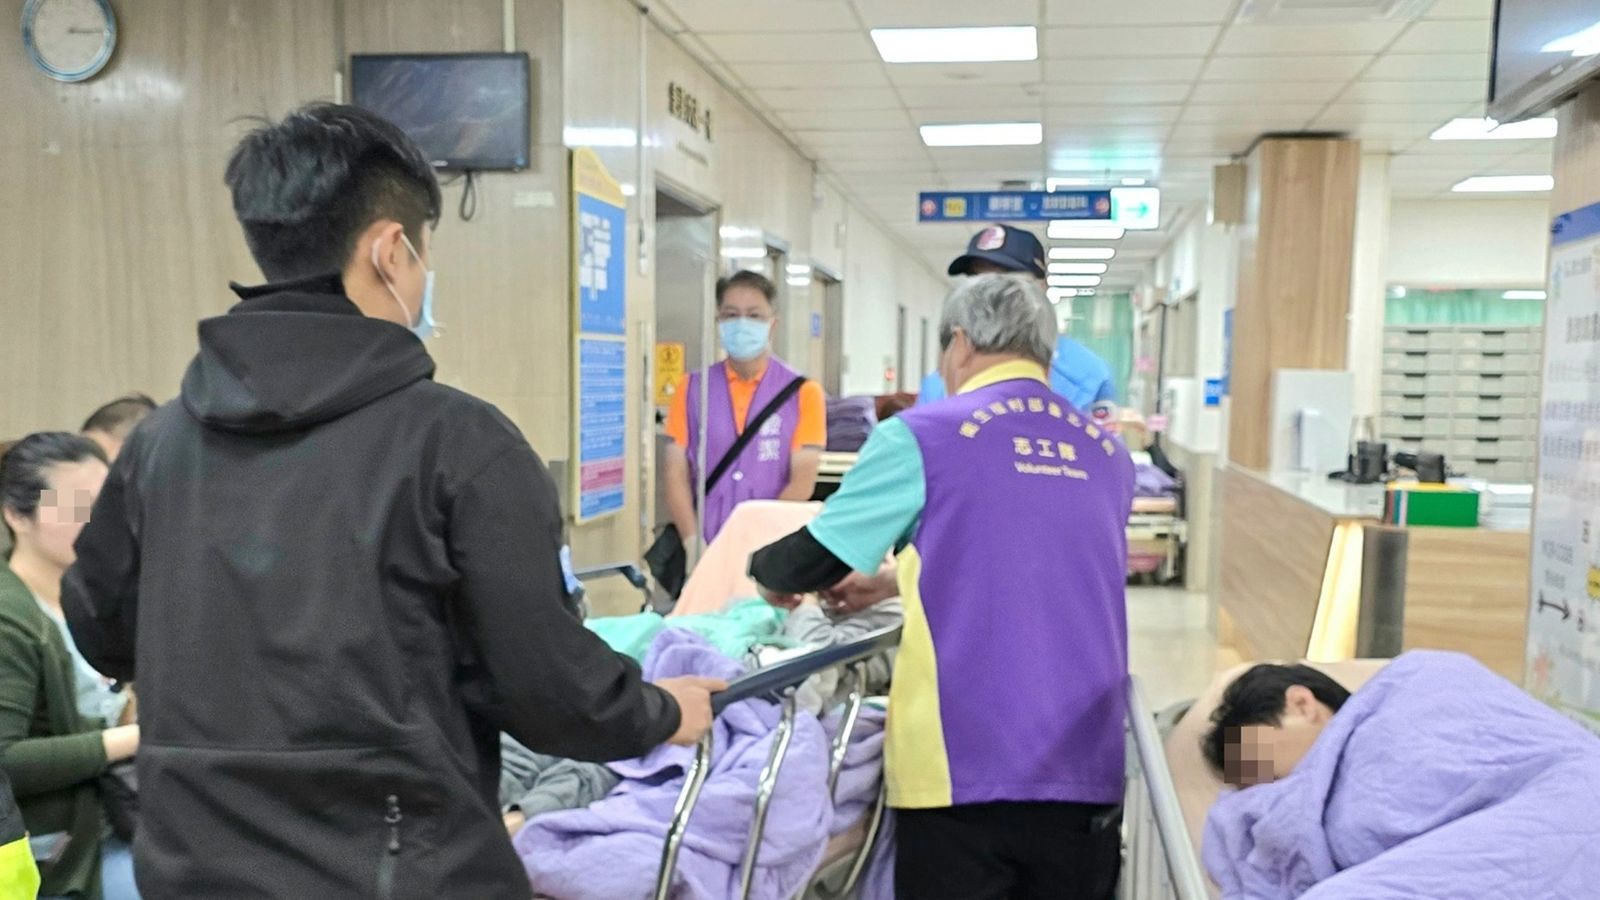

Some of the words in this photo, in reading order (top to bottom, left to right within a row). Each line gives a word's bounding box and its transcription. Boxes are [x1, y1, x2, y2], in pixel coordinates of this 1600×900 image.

[1012, 436, 1077, 462] 志工隊
[1014, 461, 1061, 476] Volunteer
[1062, 465, 1089, 480] Team
